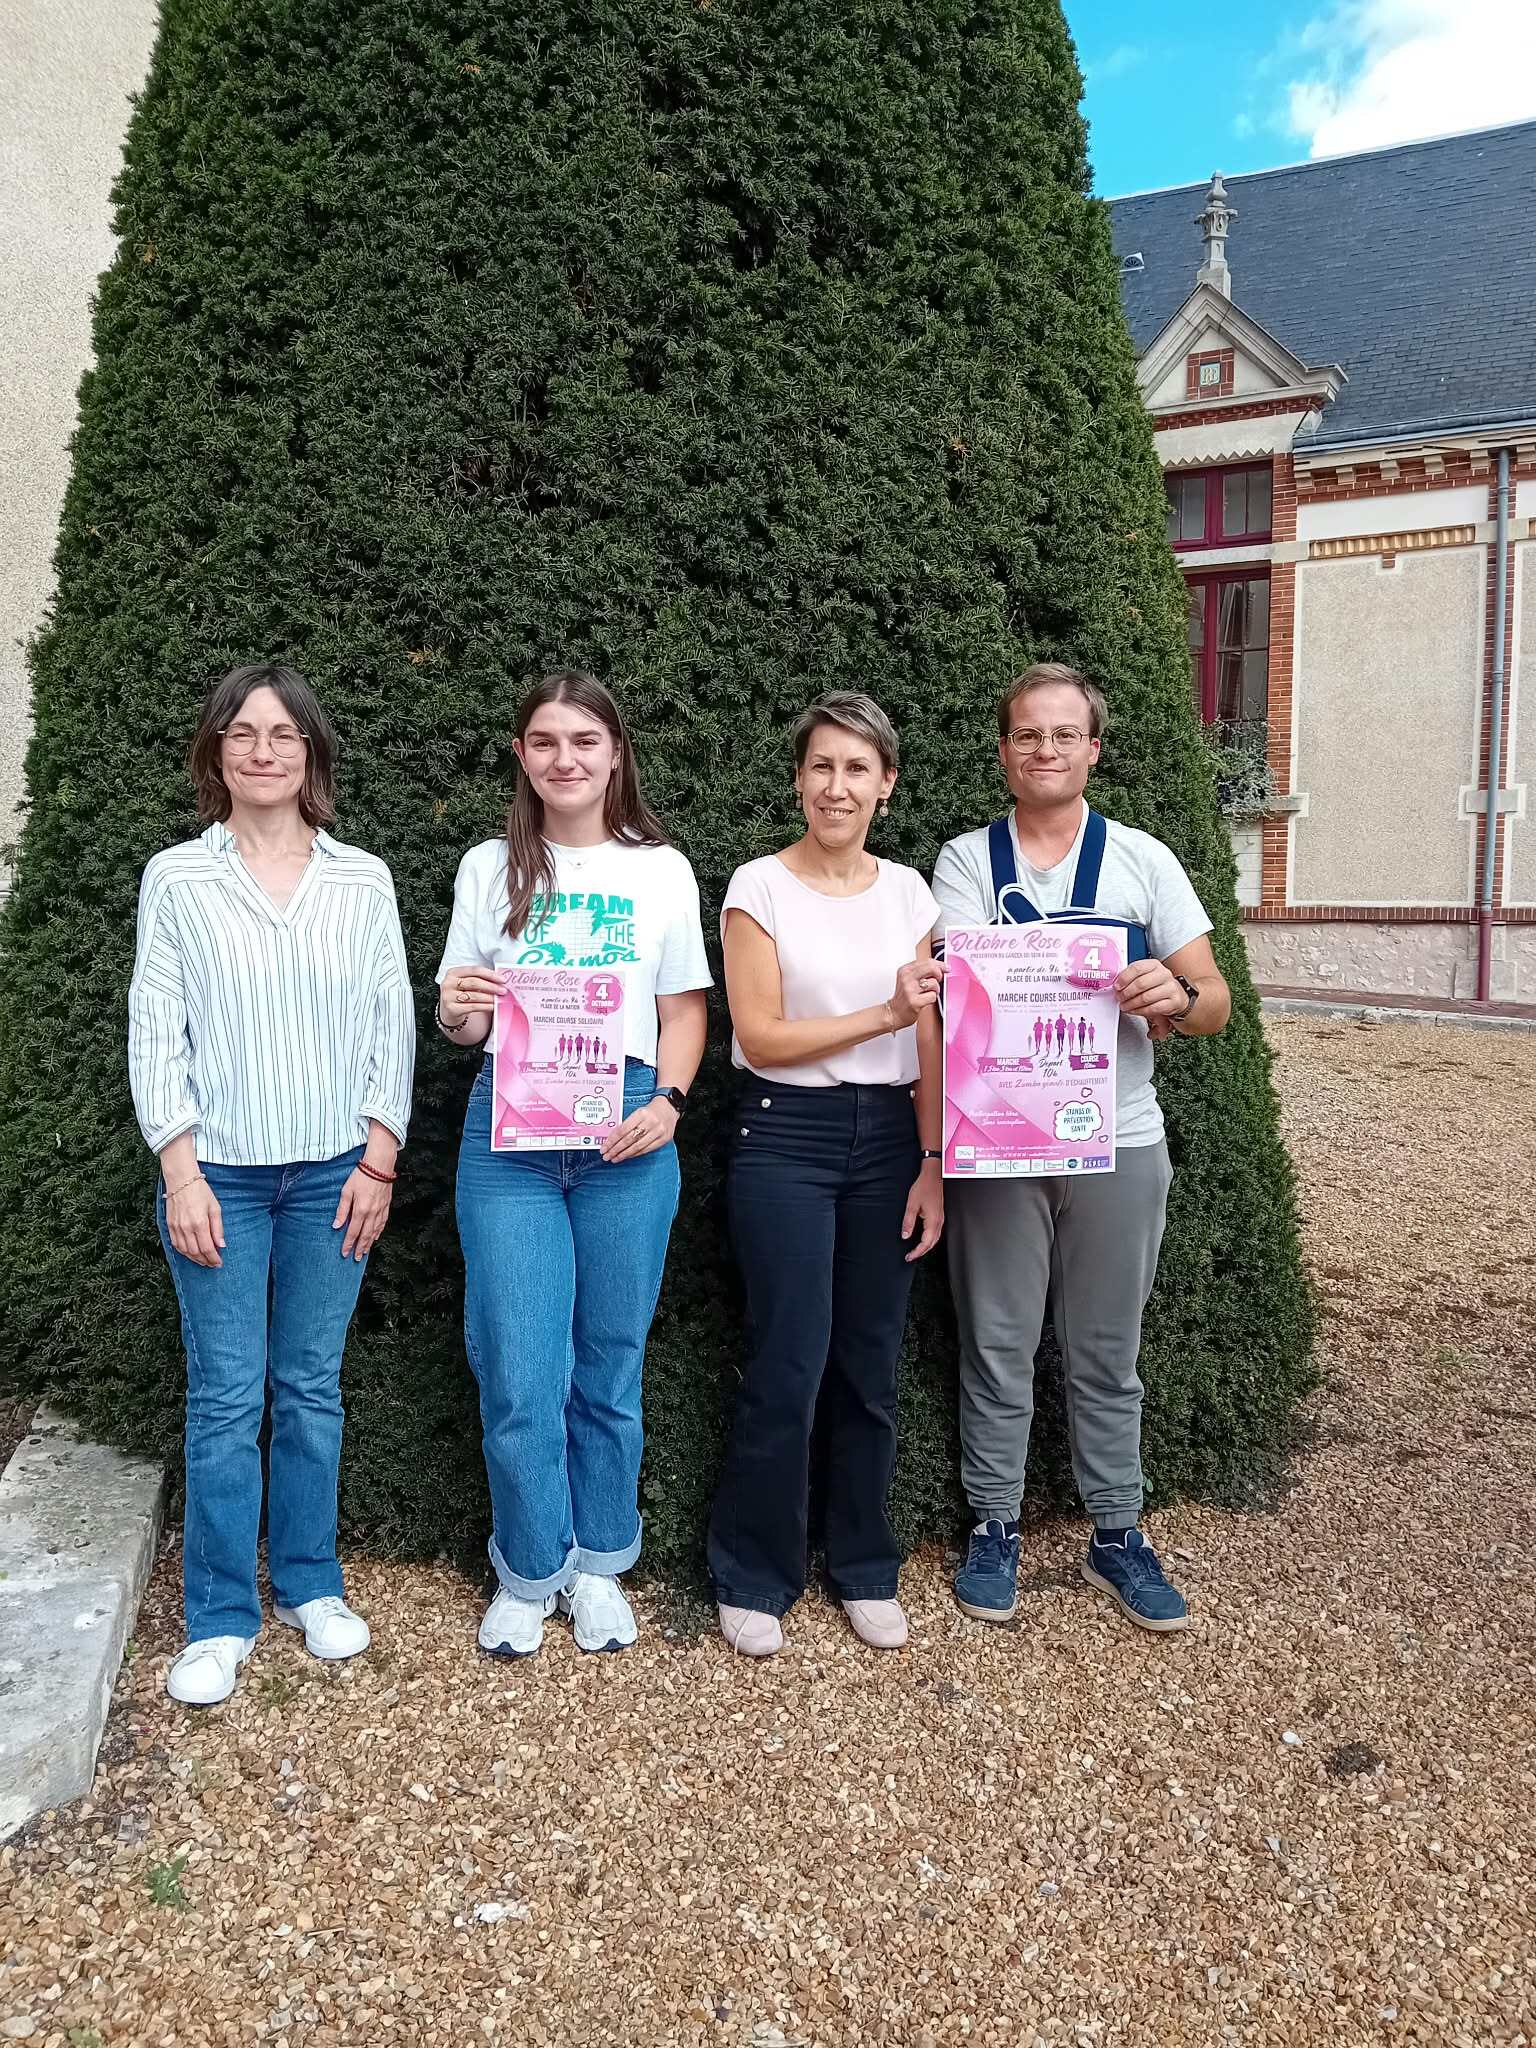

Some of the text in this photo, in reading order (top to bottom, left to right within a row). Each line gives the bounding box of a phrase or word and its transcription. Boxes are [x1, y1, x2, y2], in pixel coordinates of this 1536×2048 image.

[531, 893, 633, 916] DREAM
[524, 919, 635, 945] OF THE
[951, 931, 1018, 952] Octobre
[1023, 930, 1062, 951] Rose
[1084, 946, 1101, 970] 4
[501, 970, 550, 985] Octobre
[553, 970, 580, 986] Rose
[1077, 969, 1110, 979] OCTOBRE
[595, 983, 609, 1000] 4
[997, 991, 1092, 1002] MARCHE COURSE SOLIDAIRE
[556, 1015, 577, 1024] COURSE
